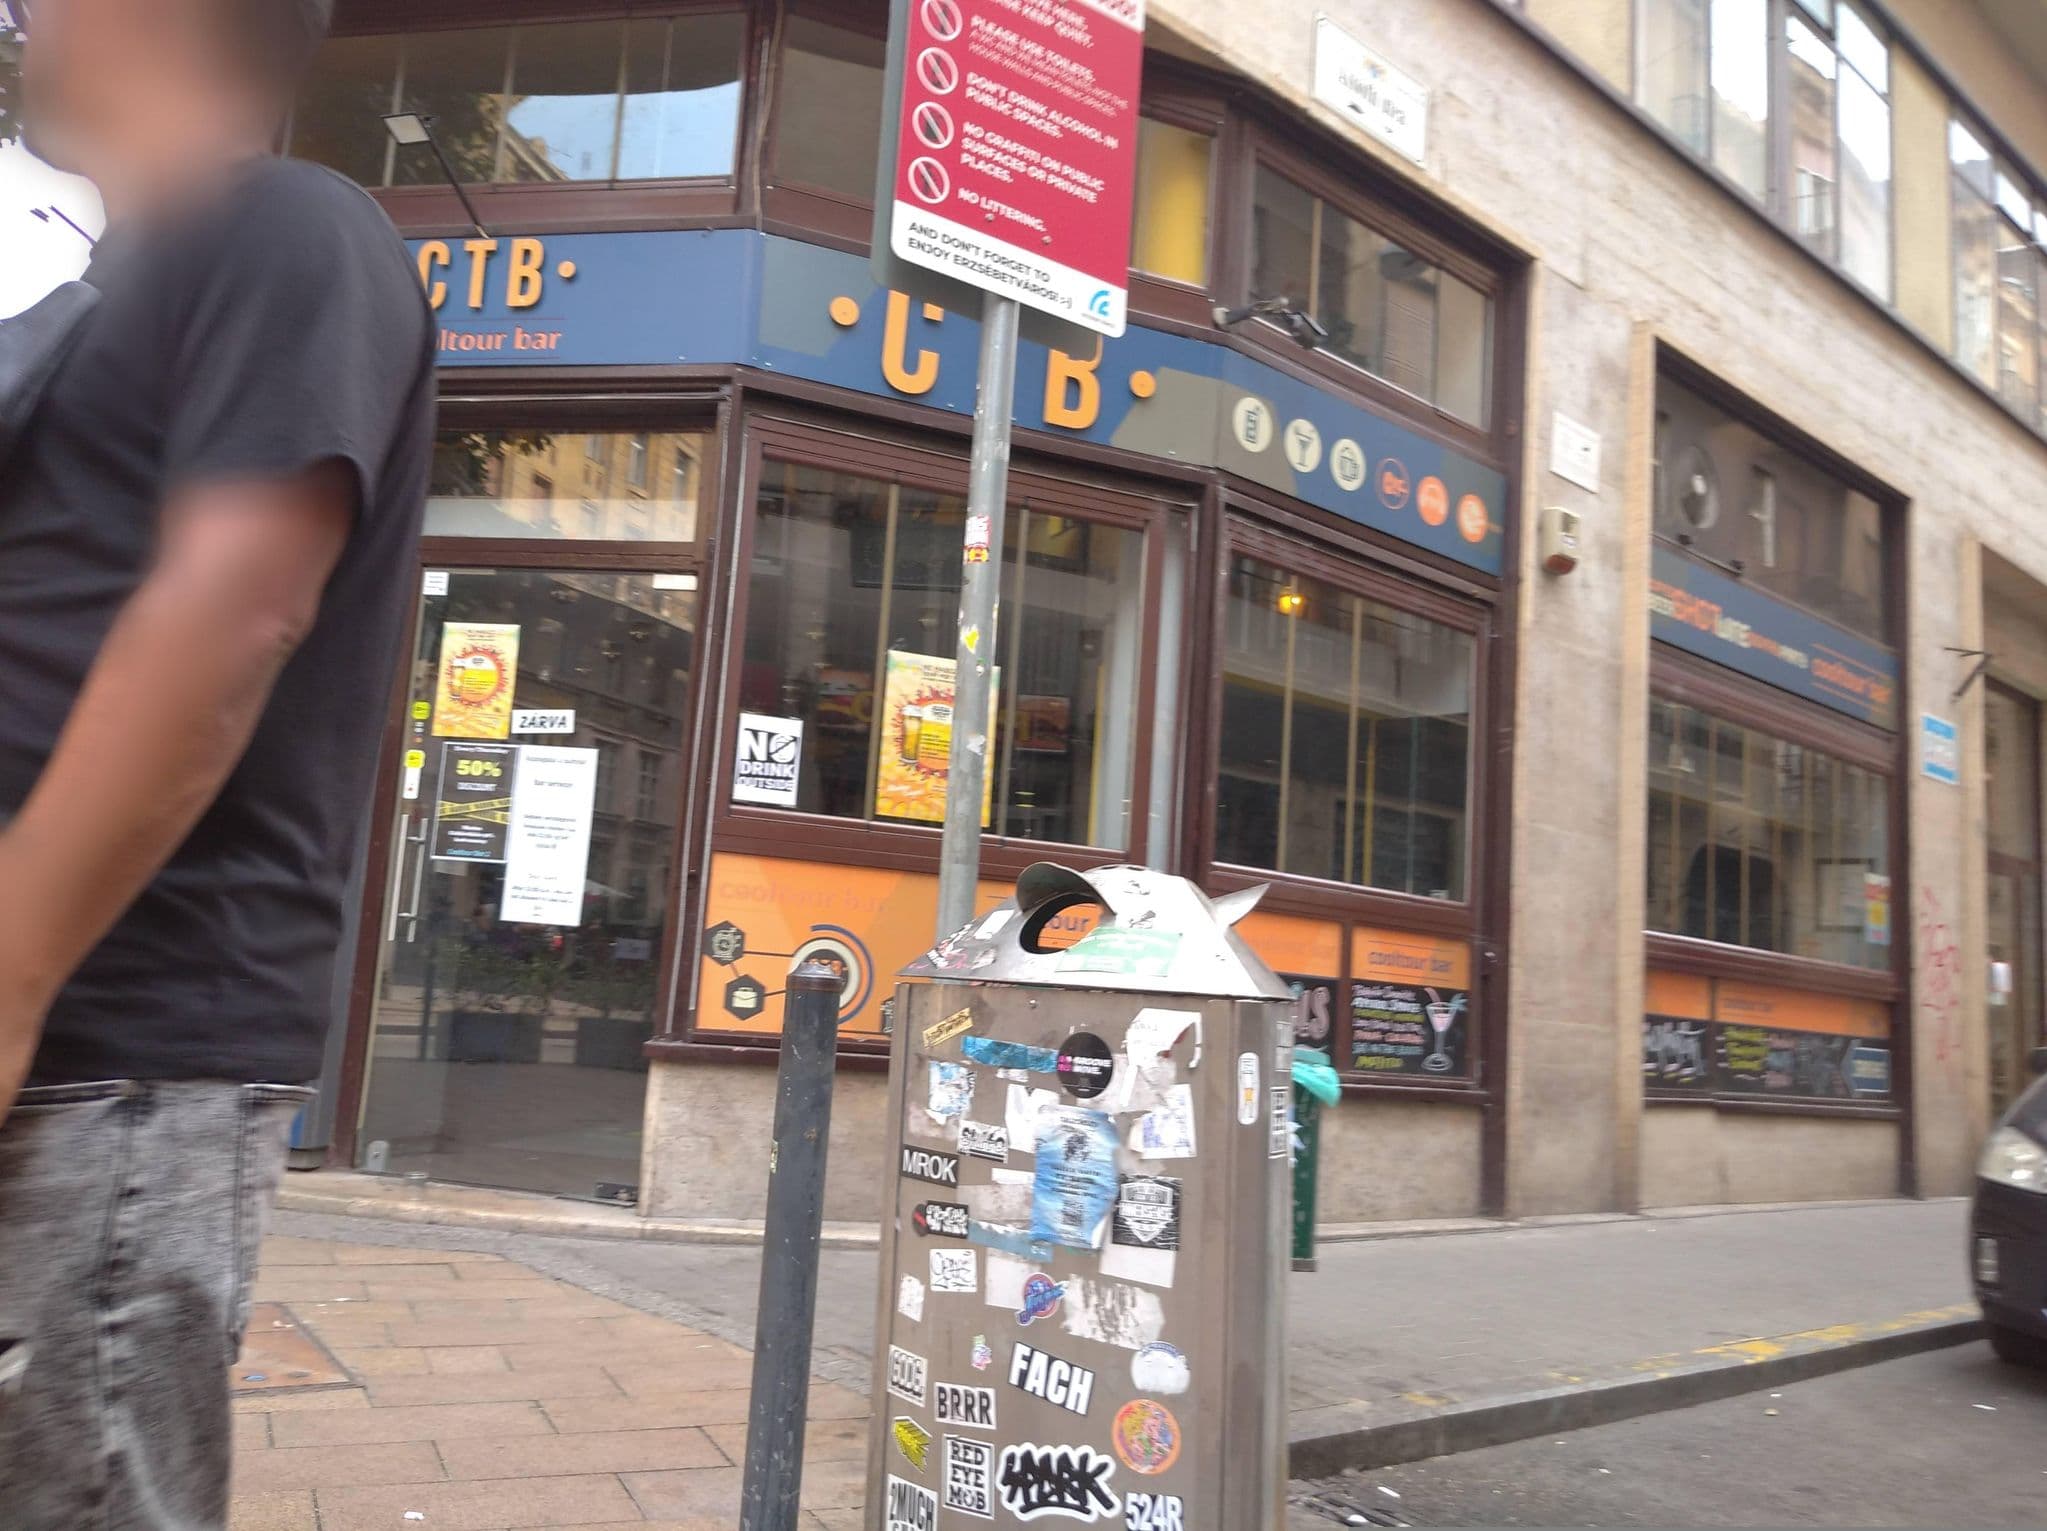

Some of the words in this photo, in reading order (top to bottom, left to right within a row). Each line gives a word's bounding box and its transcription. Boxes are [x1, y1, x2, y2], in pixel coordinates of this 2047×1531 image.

[970, 14, 1020, 44] PLEASE
[1019, 37, 1045, 58] USE
[965, 86, 1012, 116] PUBLIC
[966, 71, 1008, 98] DON'T
[1007, 90, 1048, 117] DRINK
[1047, 110, 1103, 144] ALCOHOL
[1103, 135, 1119, 150] IN
[961, 137, 1027, 172] SURFACES
[1027, 165, 1047, 181] OR
[1047, 173, 1098, 204] PRIVATE
[962, 121, 984, 138] NO
[985, 131, 1041, 163] GRAFFITI
[1041, 156, 1061, 173] ON
[1061, 164, 1104, 191] PUBLIC
[957, 187, 979, 204] NO
[908, 237, 949, 261] ENJOY
[908, 222, 938, 241] AND
[941, 233, 981, 256] DON'T
[983, 249, 1032, 277] FORGET
[1033, 268, 1051, 283] TO
[416, 238, 544, 310] CTB
[514, 325, 561, 350] bar
[882, 290, 1104, 429] CB
[740, 729, 796, 763] NO
[456, 759, 502, 777] 50%
[739, 761, 794, 777] DRINK
[903, 1149, 957, 1183] MROK
[1009, 1342, 1093, 1415] FACH
[936, 1386, 993, 1426] BRRR
[950, 1441, 984, 1466] RED
[950, 1463, 985, 1488] EYE
[949, 1484, 985, 1510] MOB
[1125, 1492, 1183, 1531] 524R
